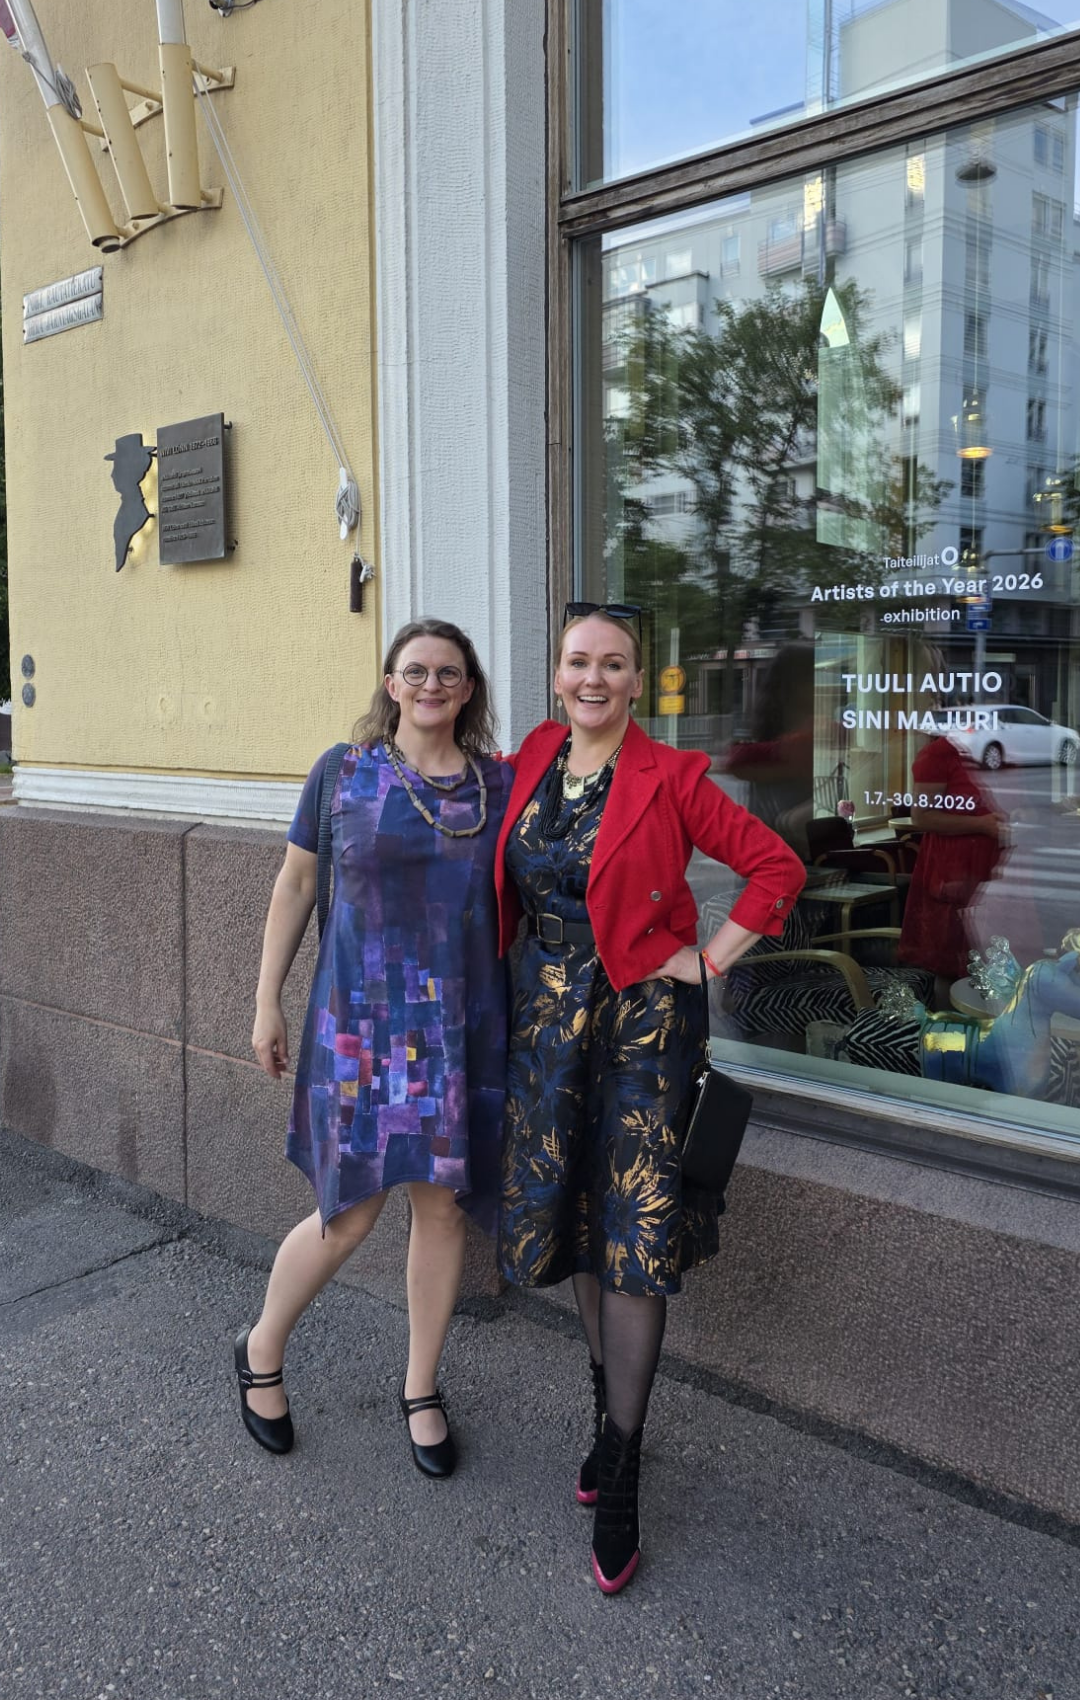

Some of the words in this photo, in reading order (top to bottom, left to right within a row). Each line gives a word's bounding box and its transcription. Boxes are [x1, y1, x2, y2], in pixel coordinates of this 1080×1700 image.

[883, 554, 939, 569] Taiteilijat
[810, 584, 875, 602] Artists
[879, 581, 900, 598] of
[903, 580, 936, 597] the
[942, 577, 987, 595] Year
[992, 573, 1044, 592] 2026
[842, 673, 912, 693] TUULI
[920, 672, 1002, 693] AUTIO
[842, 710, 889, 730] SINI
[897, 710, 999, 731] MAJURI
